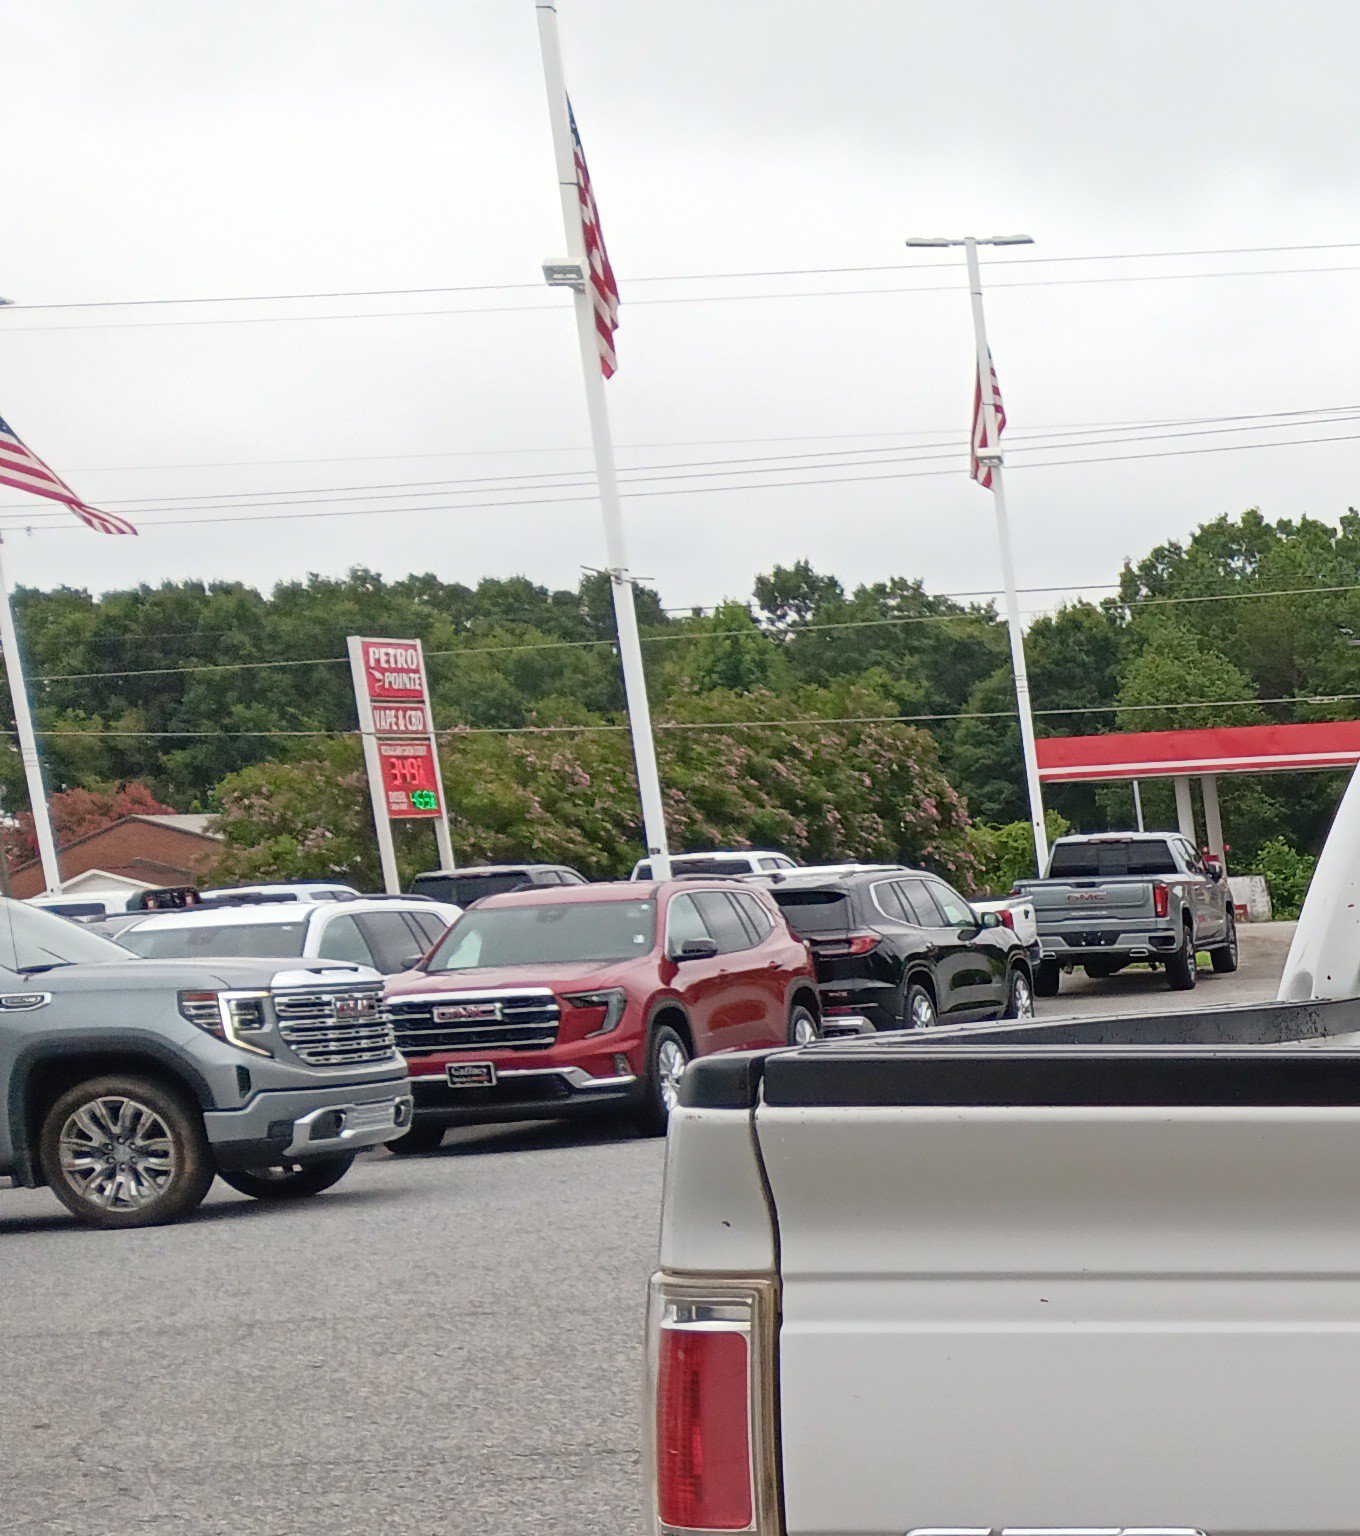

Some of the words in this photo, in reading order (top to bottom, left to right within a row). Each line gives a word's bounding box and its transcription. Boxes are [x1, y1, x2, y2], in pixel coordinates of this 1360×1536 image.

[368, 647, 418, 669] PETRO
[384, 673, 423, 691] POINTE
[373, 709, 398, 731] VAPE
